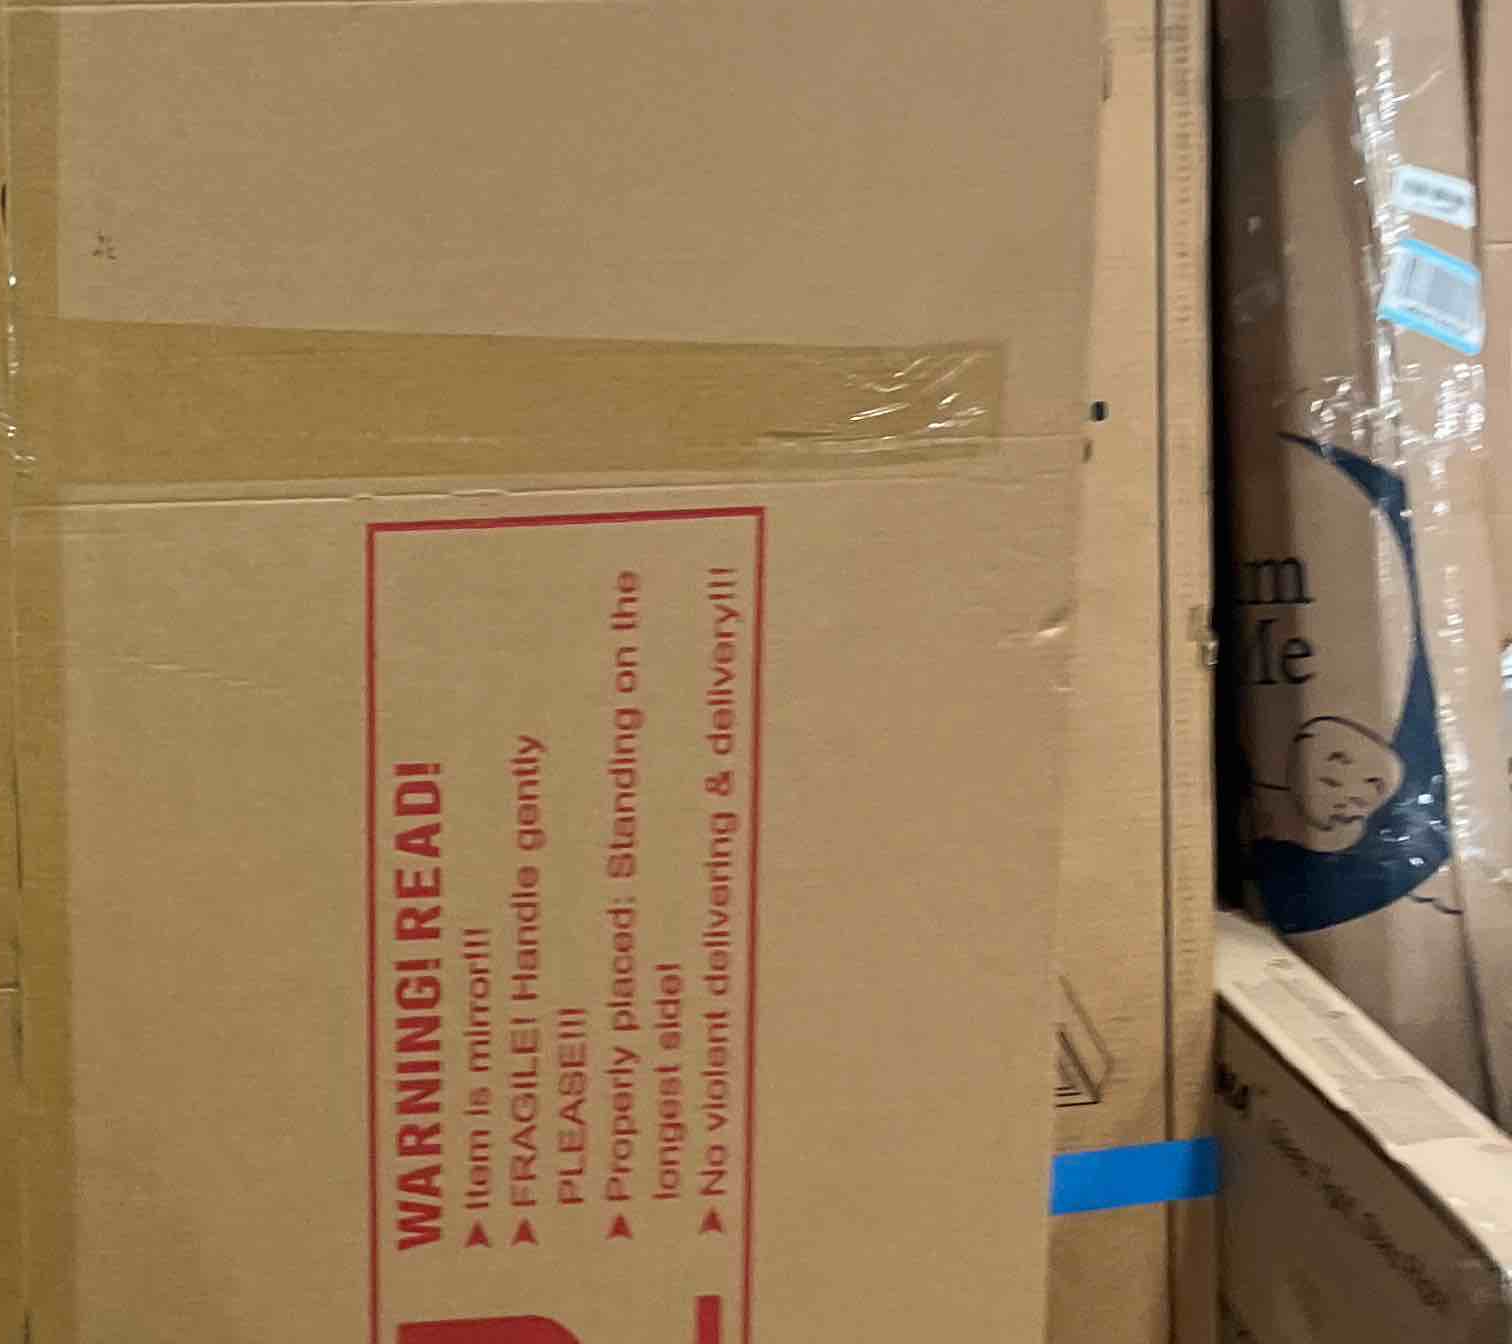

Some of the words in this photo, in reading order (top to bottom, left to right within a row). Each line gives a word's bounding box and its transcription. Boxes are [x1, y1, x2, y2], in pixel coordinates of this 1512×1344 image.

[614, 574, 639, 635] the
[615, 648, 638, 693] on
[507, 735, 548, 854] gently
[604, 705, 647, 880] Standing
[703, 769, 731, 798] &
[393, 763, 441, 941] READ!
[703, 812, 740, 996] delivering
[509, 866, 538, 1003] Handle
[655, 964, 682, 1047] side!
[394, 960, 440, 1249] WARNING!
[465, 1087, 491, 1115] is
[512, 1016, 536, 1208] FRAGILE!
[560, 1009, 586, 1208] PLEASE!!!
[609, 1049, 640, 1201] Properly
[653, 1064, 682, 1200] longest
[705, 1010, 728, 1132] violent
[464, 1130, 491, 1211] Item
[698, 1141, 727, 1197] No
